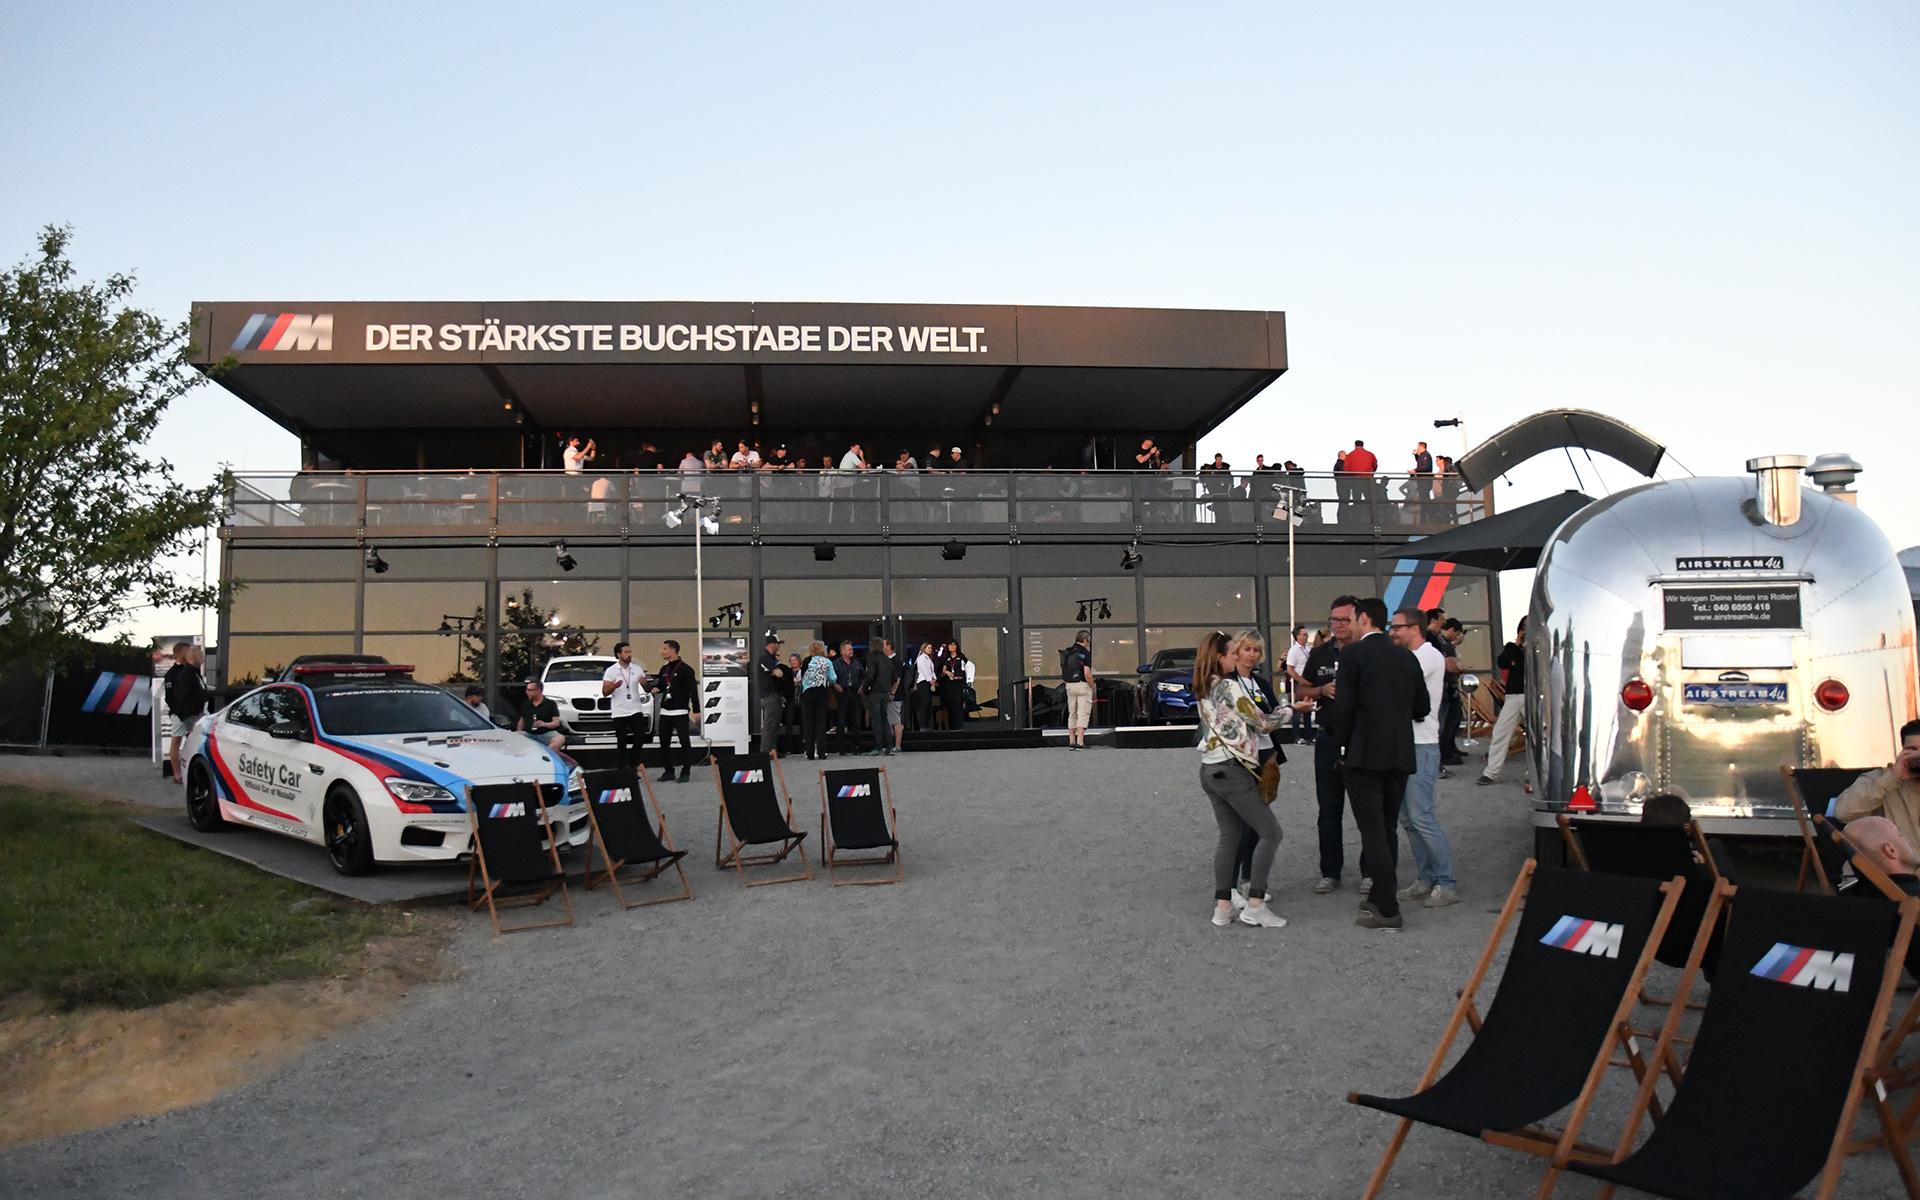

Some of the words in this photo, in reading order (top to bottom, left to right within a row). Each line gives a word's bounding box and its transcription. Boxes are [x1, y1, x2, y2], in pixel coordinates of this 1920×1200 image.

[365, 325, 433, 351] DER
[439, 319, 614, 351] STÄRKSTE
[619, 325, 822, 352] BUCHSTABE
[828, 326, 894, 352] DER
[898, 327, 988, 353] WELT.
[1680, 594, 1709, 603] bringen
[1734, 593, 1756, 601] Ideen
[1757, 593, 1769, 601] ins
[1770, 592, 1798, 601] Rollen!
[1754, 603, 1771, 611] 418
[1693, 613, 1771, 621] www.airstream4u.de
[239, 753, 275, 785] Safety
[279, 764, 302, 788] Car
